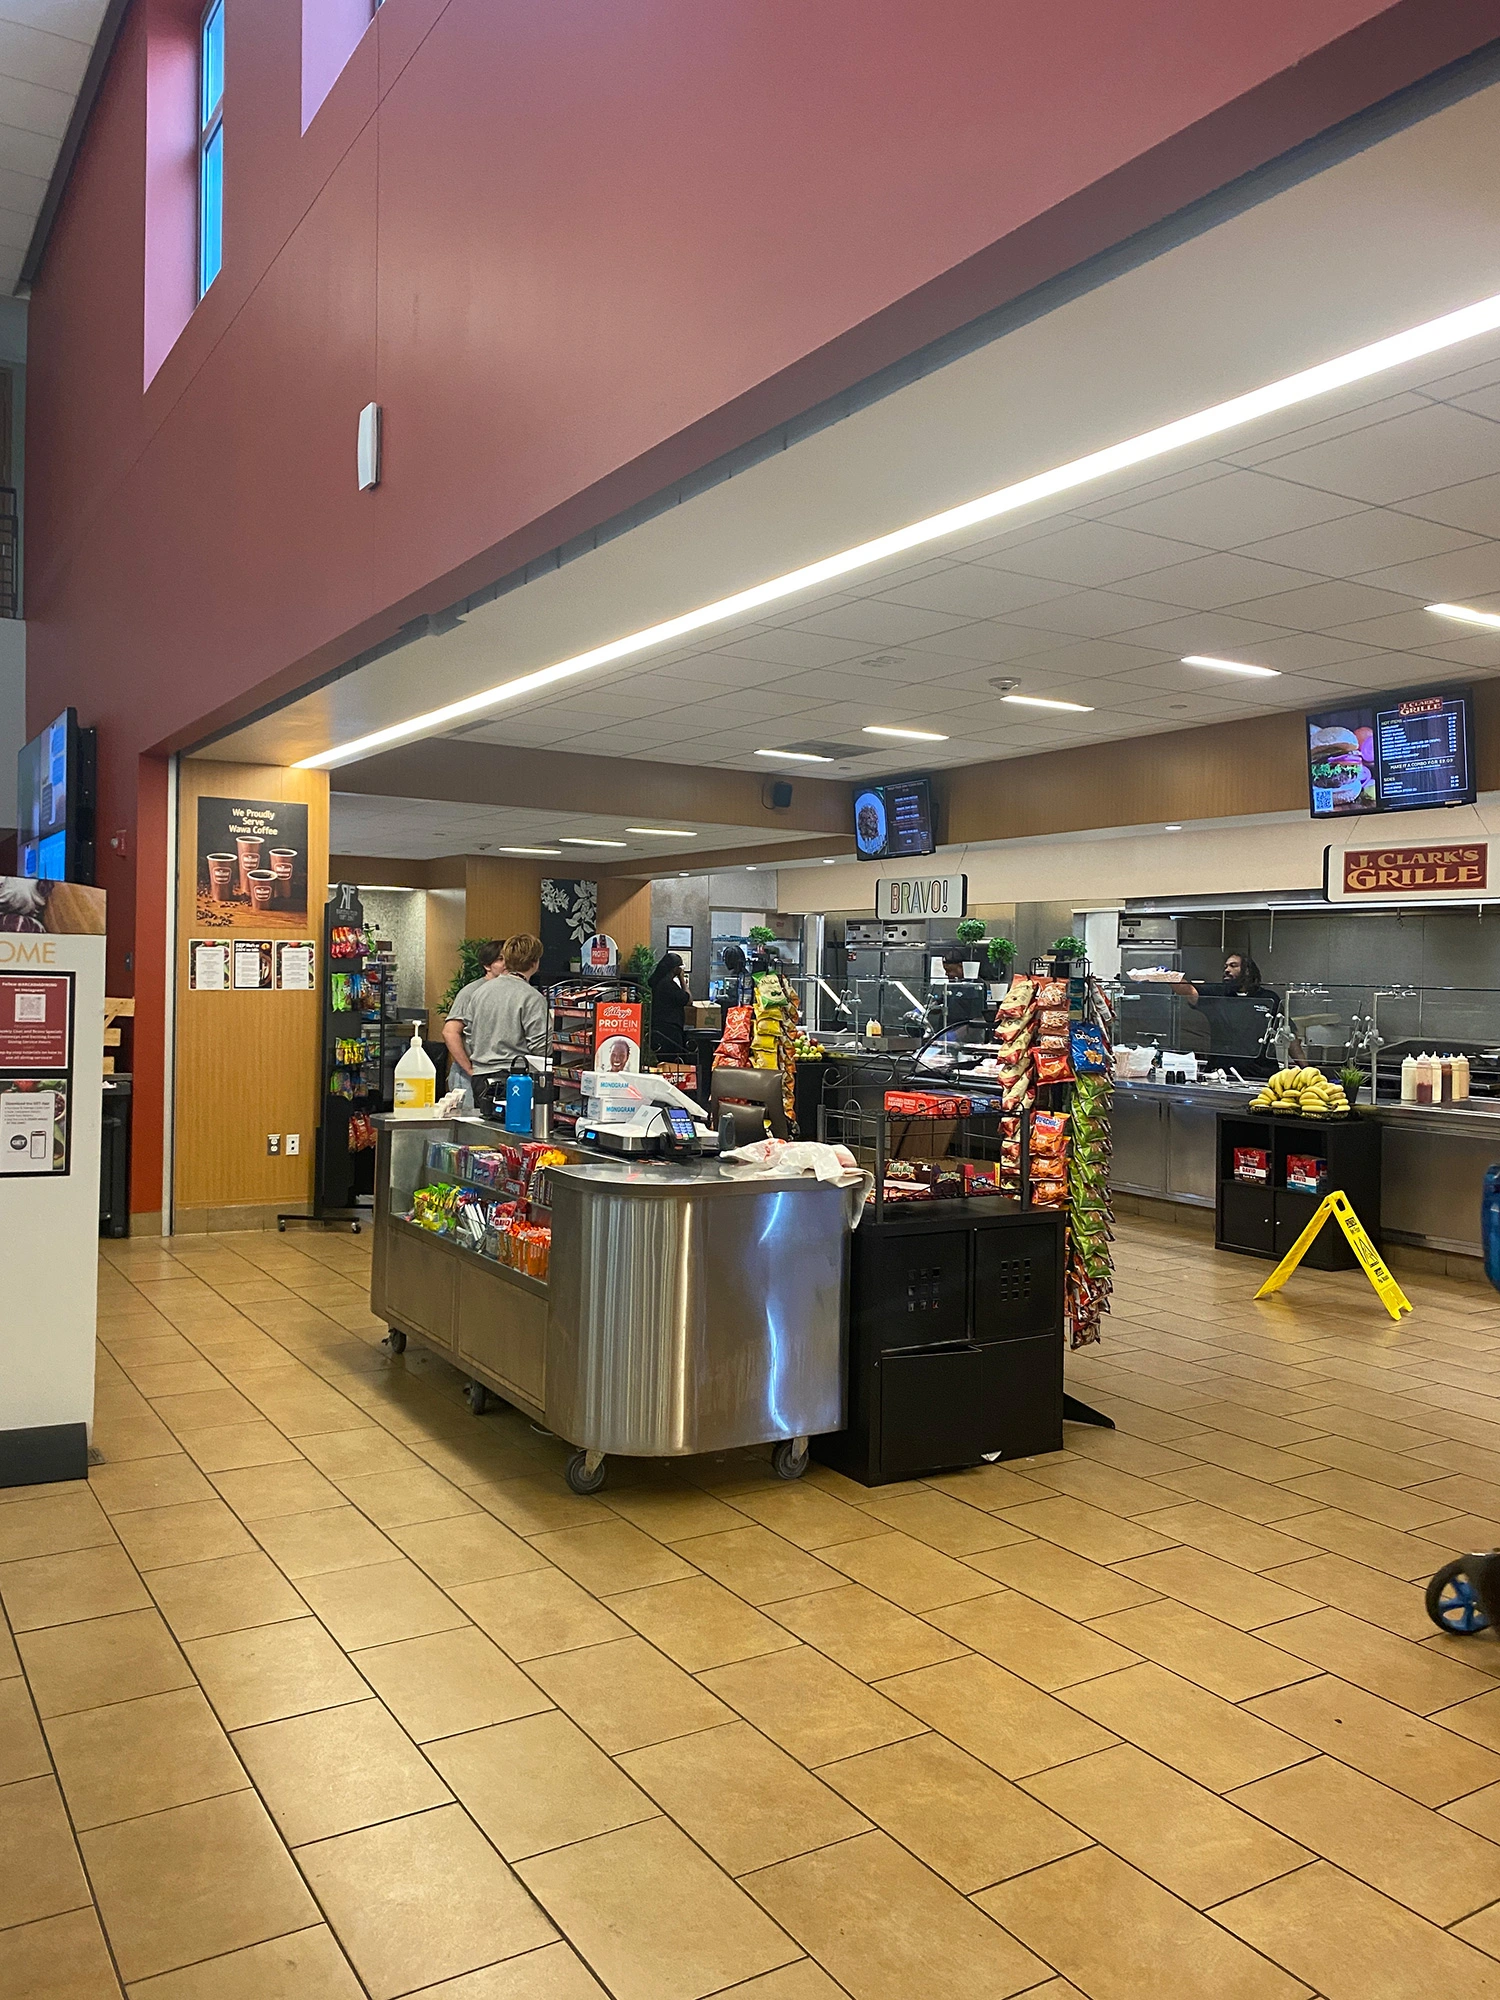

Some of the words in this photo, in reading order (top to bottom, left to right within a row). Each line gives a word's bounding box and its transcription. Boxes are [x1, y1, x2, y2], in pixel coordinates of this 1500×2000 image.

[1400, 703, 1442, 716] GRILLE
[232, 808, 245, 816] We
[246, 809, 276, 820] Proudly
[242, 817, 264, 826] Serve
[228, 824, 251, 834] Wawa
[252, 826, 278, 836] Coffee
[1350, 855, 1373, 870] J.
[1378, 849, 1480, 868] CLARK'S
[1347, 866, 1482, 890] GRILLE
[890, 880, 948, 914] BRAVO!
[603, 1006, 632, 1018] Kellogg's
[598, 1019, 638, 1028] PROTEIN
[1074, 1032, 1100, 1044] Doritos
